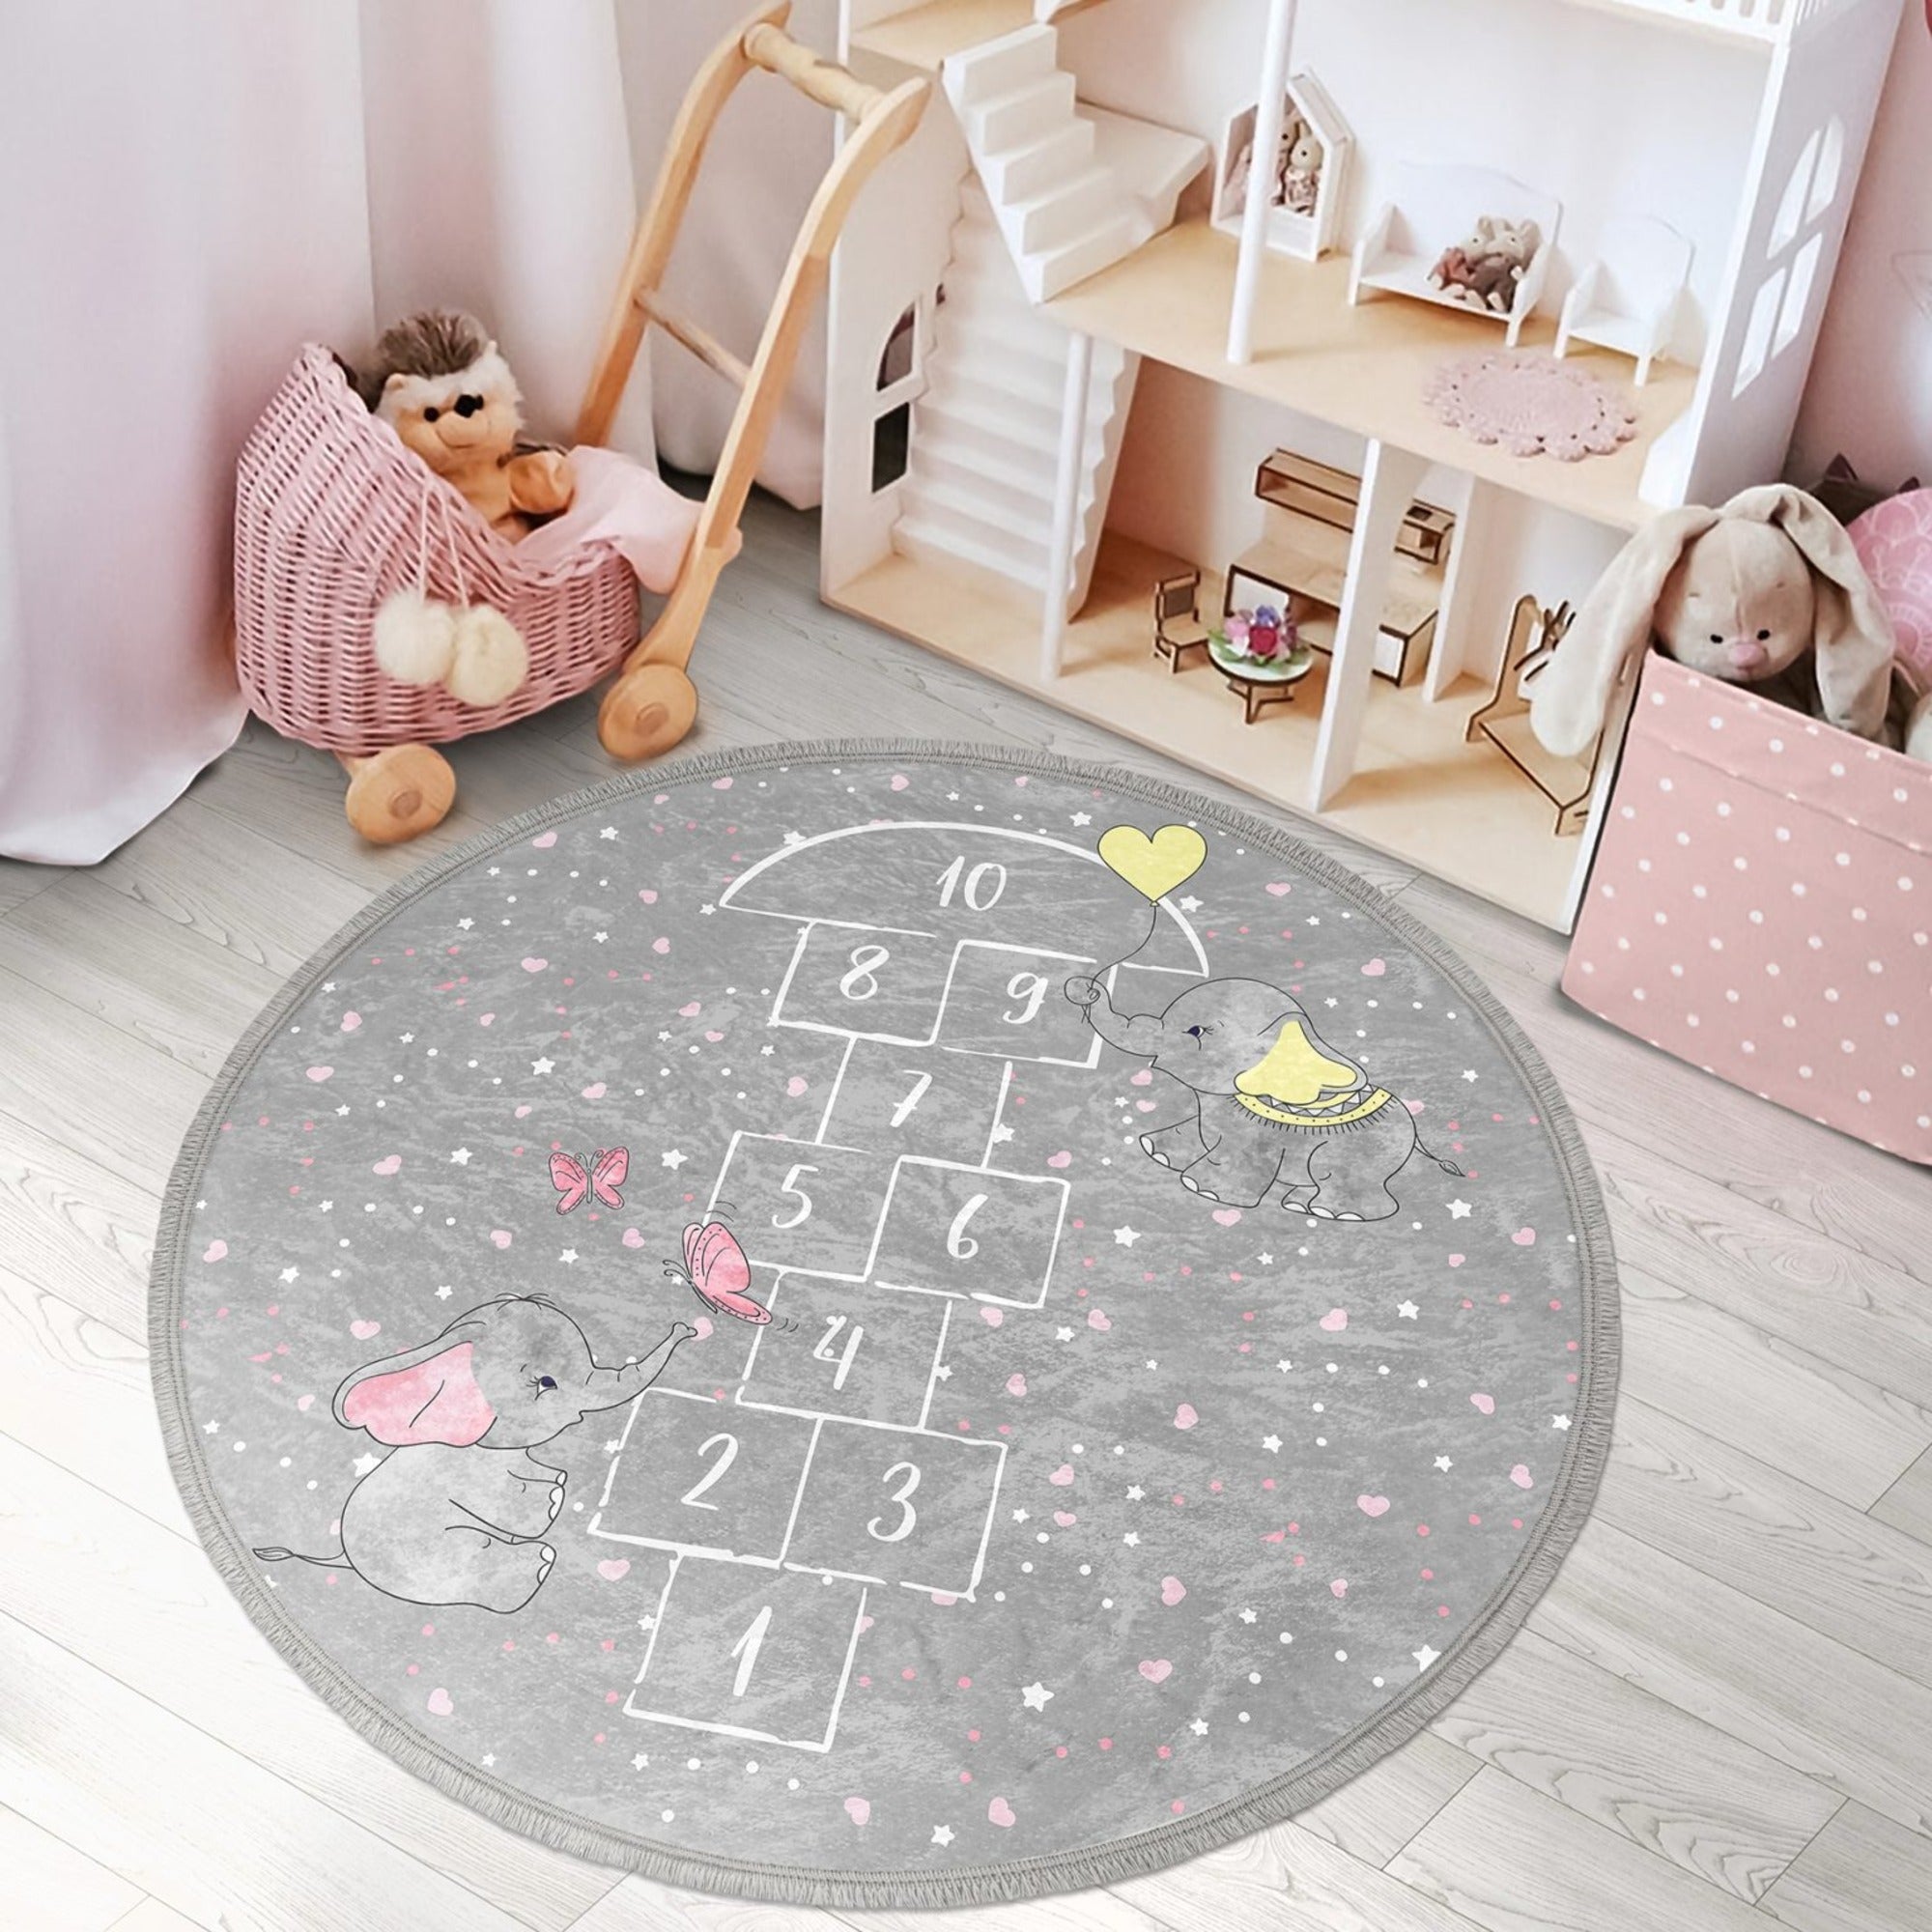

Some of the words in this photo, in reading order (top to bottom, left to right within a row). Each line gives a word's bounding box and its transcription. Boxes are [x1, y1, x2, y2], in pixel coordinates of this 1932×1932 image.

[935, 855, 1007, 911] 10
[839, 945, 890, 1000] 8
[1003, 972, 1049, 1024] 9
[890, 1069, 932, 1127] 7
[772, 1164, 819, 1229] 5
[946, 1194, 988, 1258] 6
[812, 1315, 864, 1390] 4
[680, 1433, 738, 1511] 2
[867, 1461, 921, 1542] 3
[730, 1605, 773, 1697] 1
